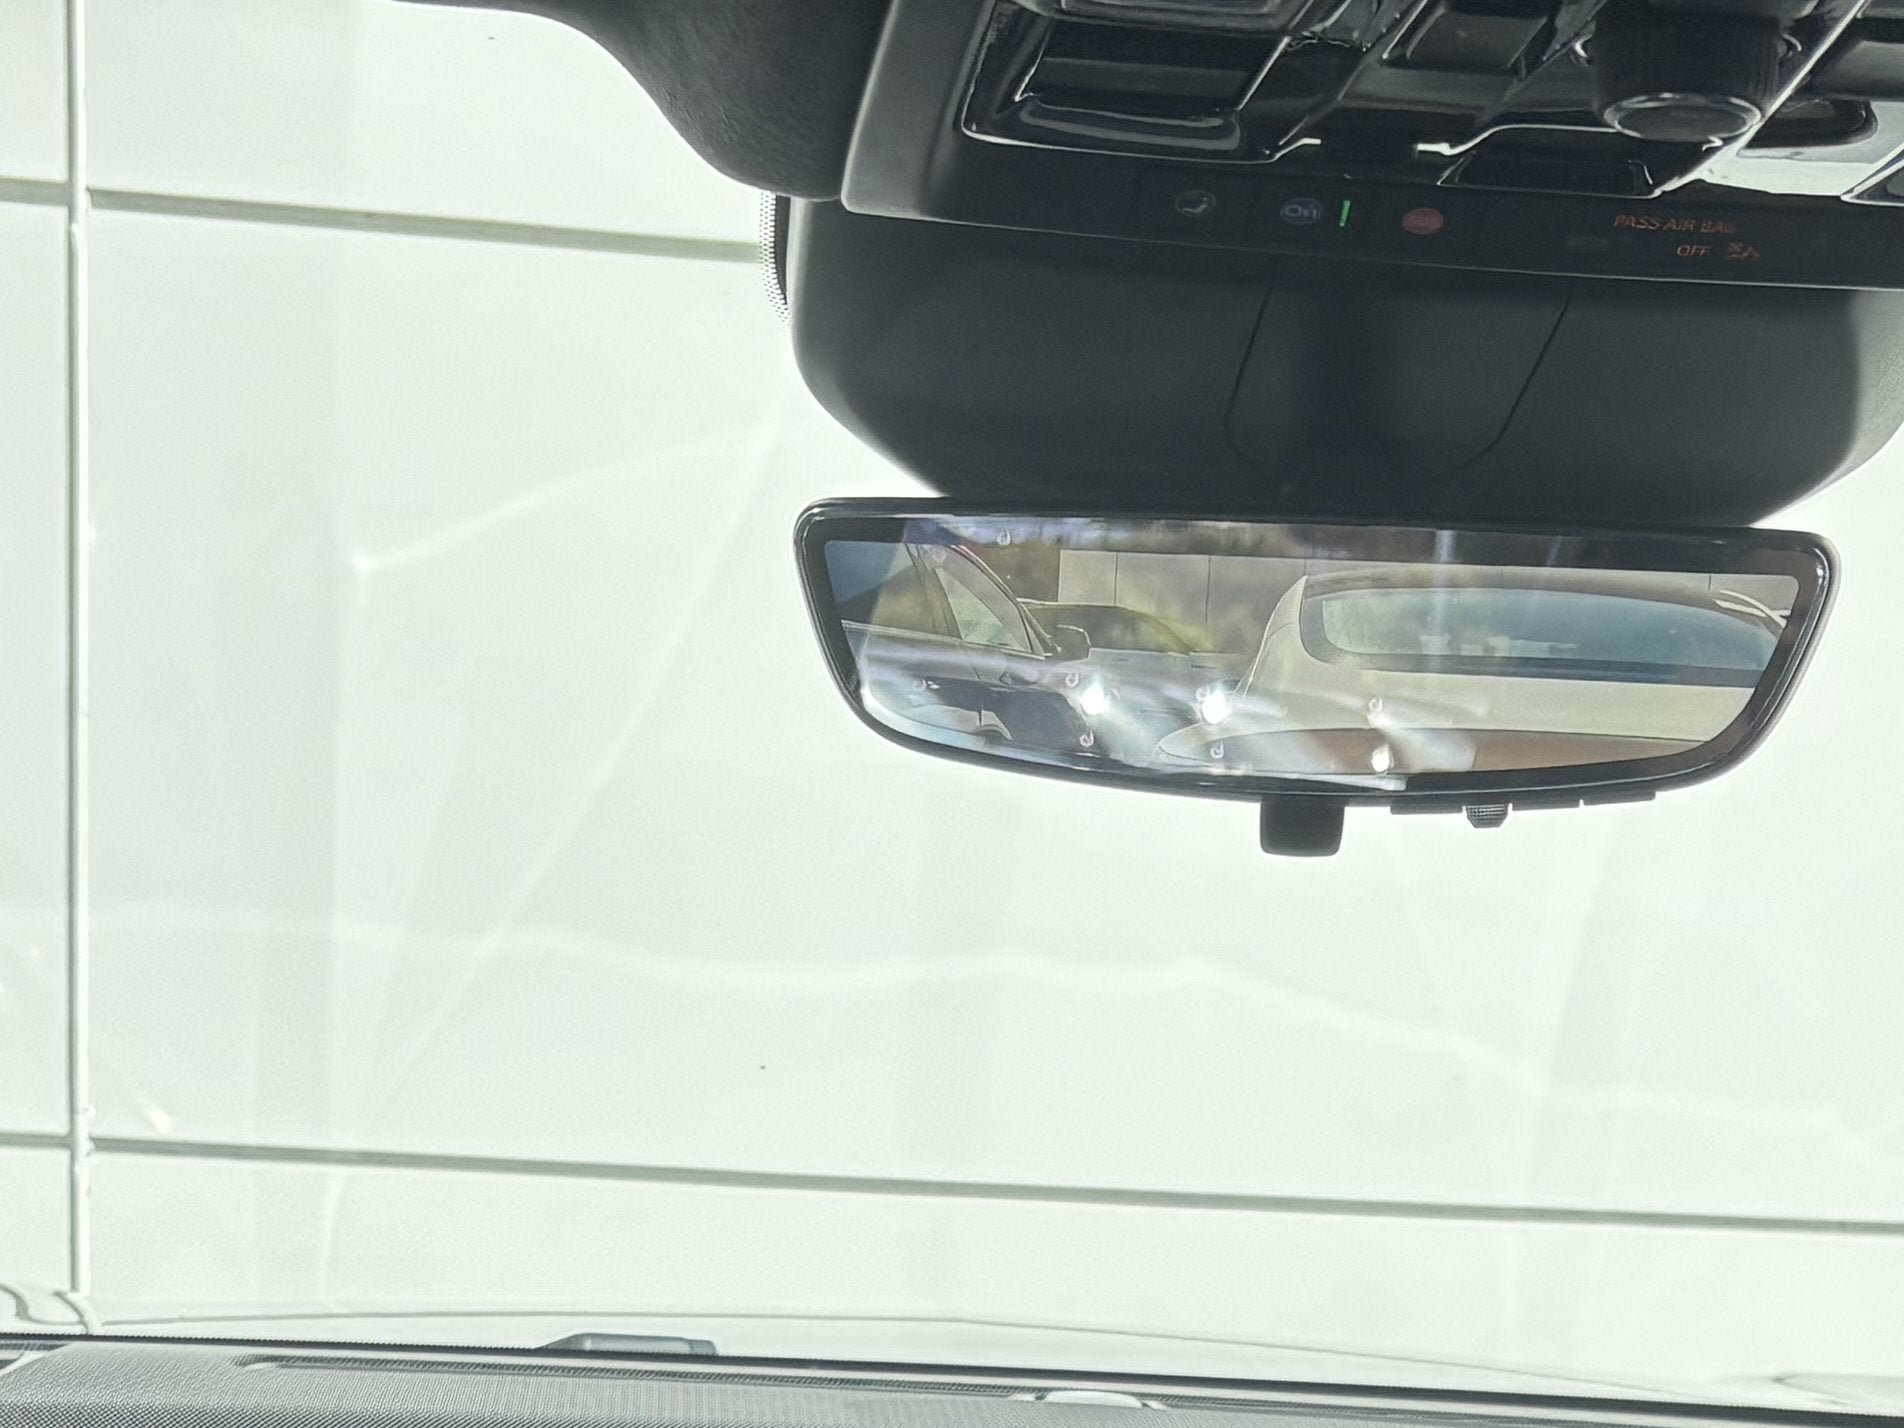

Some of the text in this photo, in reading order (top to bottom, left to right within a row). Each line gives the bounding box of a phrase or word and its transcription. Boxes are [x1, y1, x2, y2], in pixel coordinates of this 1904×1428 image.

[1613, 213, 1661, 231] PASS
[1662, 216, 1697, 233] AIR
[1677, 243, 1712, 257] OFF
